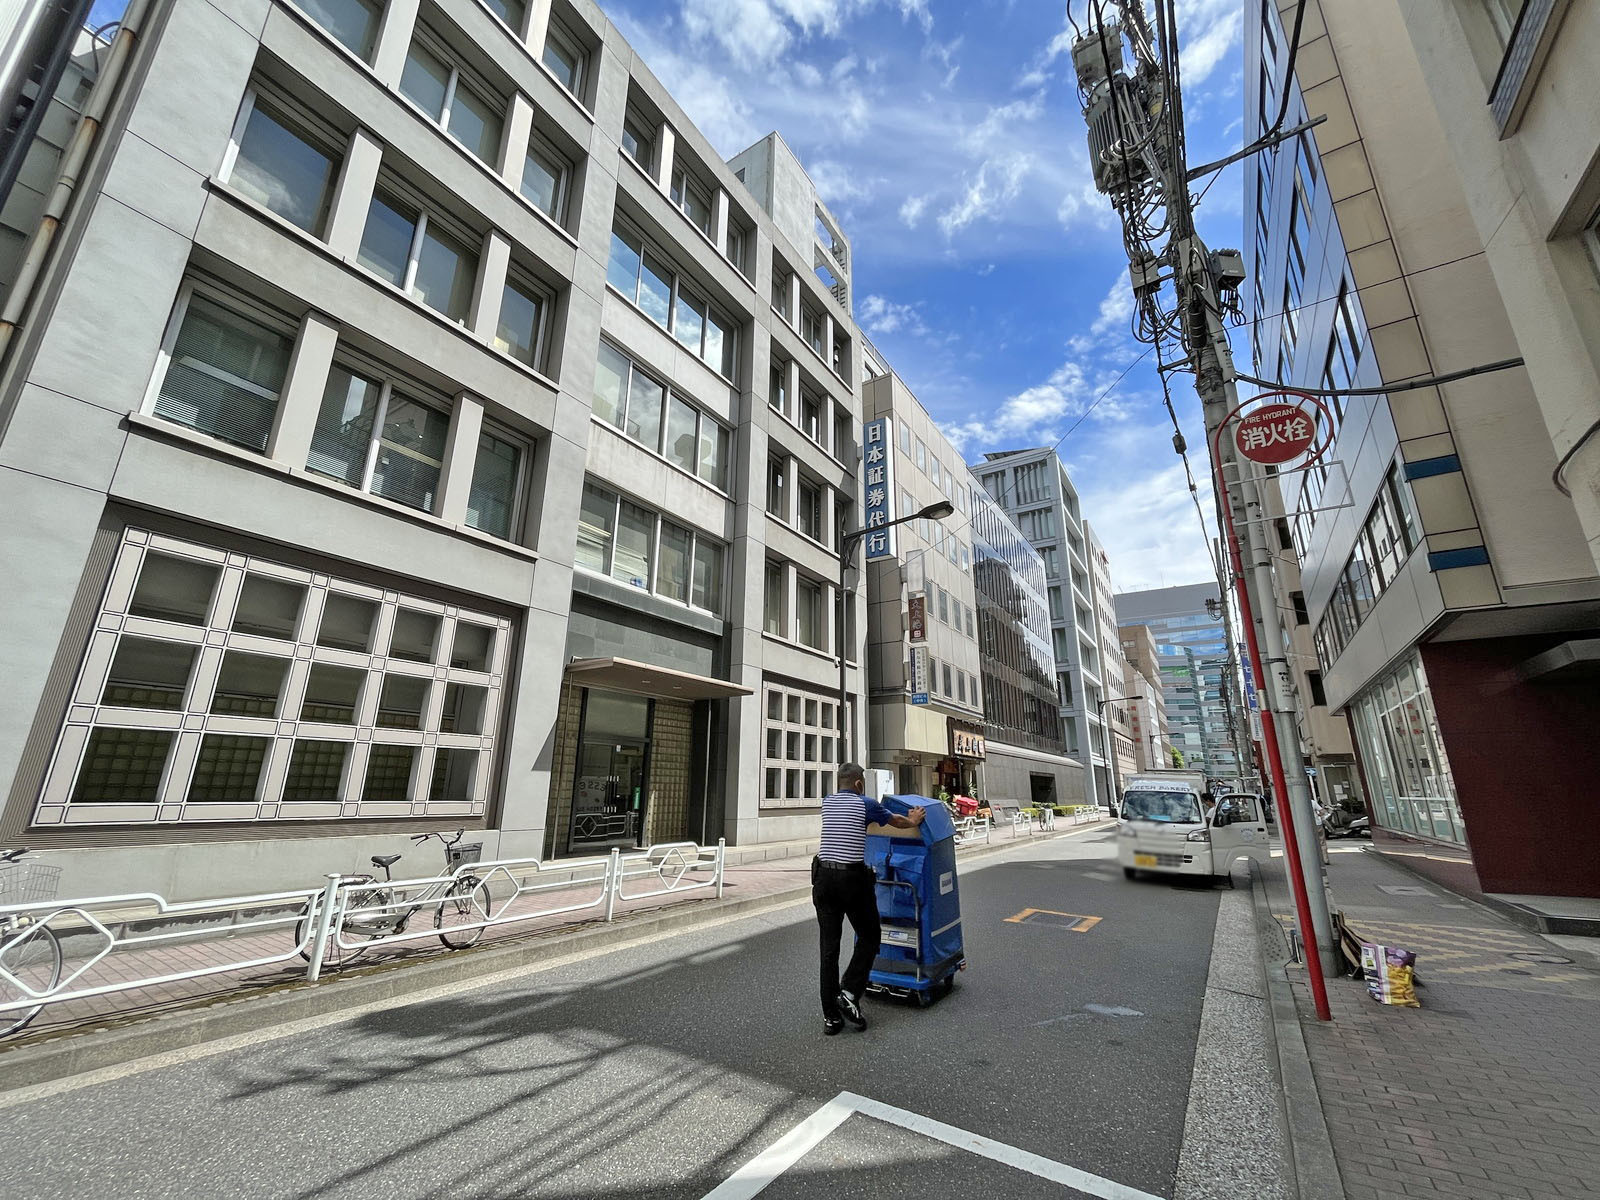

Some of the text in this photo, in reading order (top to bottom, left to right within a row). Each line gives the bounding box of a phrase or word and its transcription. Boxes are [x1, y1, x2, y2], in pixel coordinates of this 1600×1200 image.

[1244, 407, 1297, 425] FIRE HYDRANT
[1241, 417, 1310, 451] 消火栓
[867, 423, 886, 553] 日本証券代行
